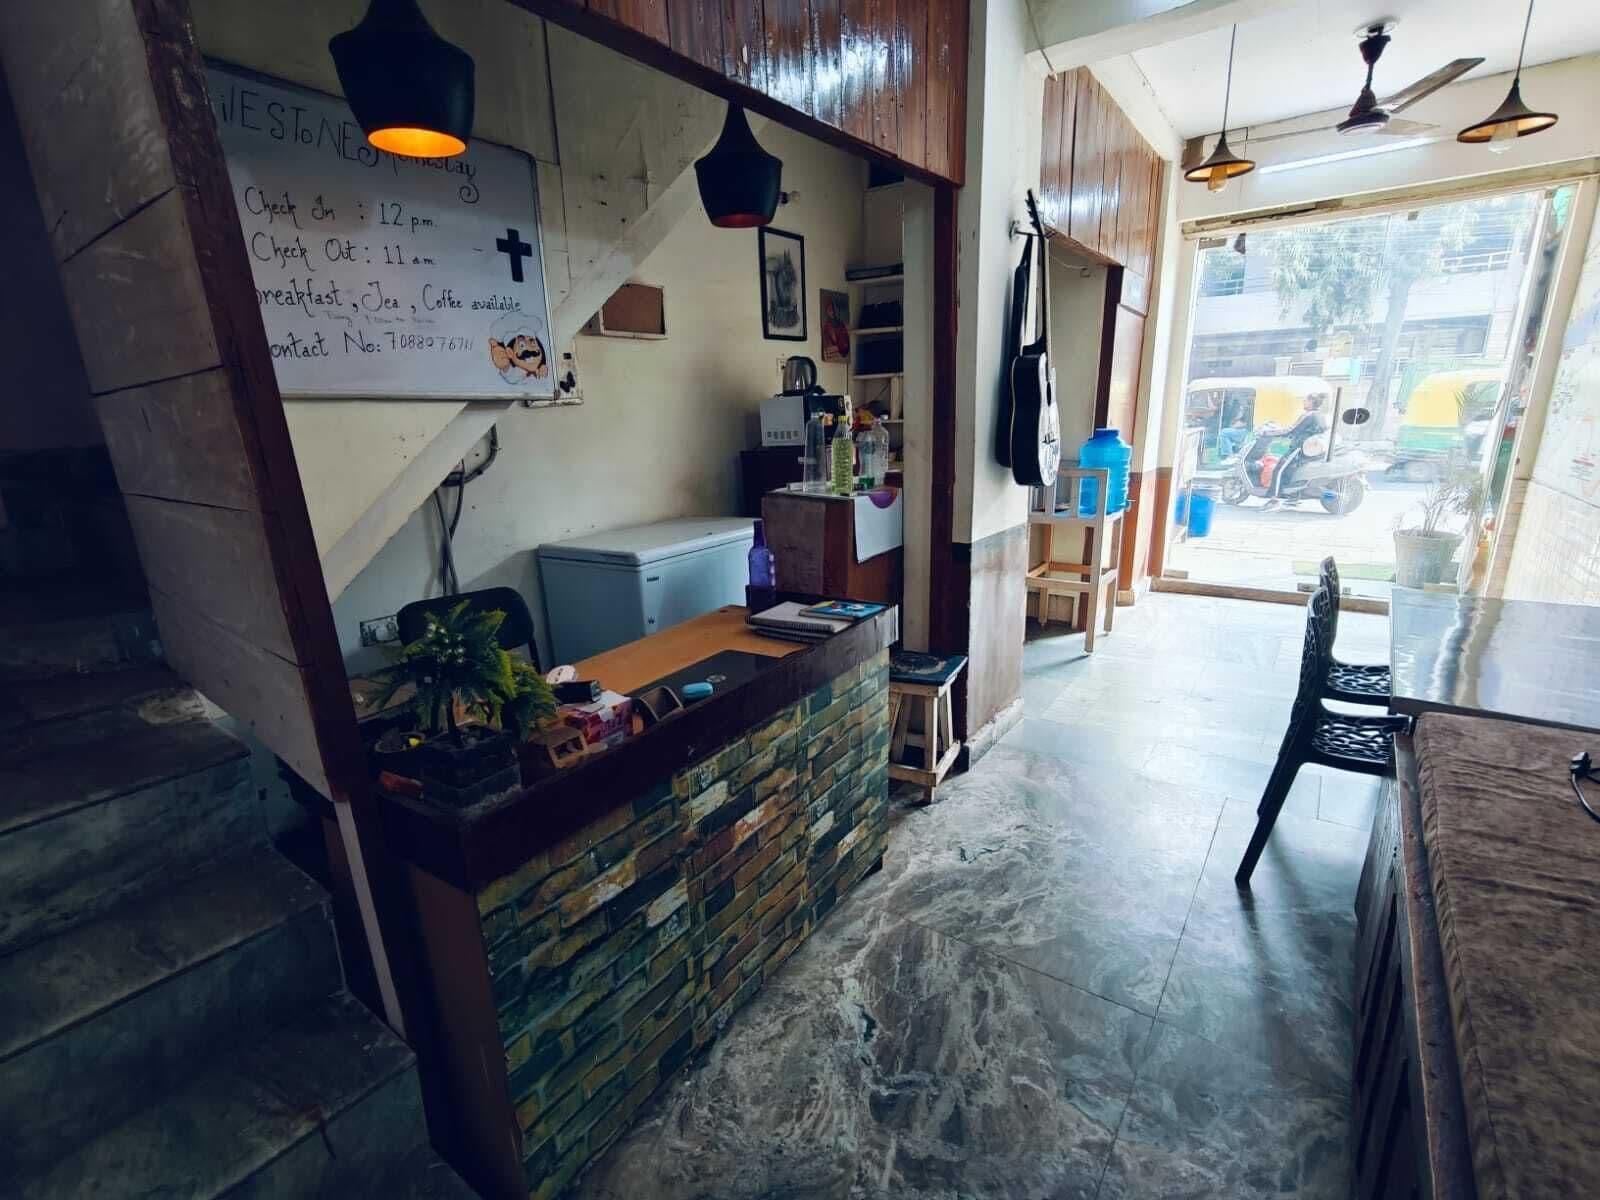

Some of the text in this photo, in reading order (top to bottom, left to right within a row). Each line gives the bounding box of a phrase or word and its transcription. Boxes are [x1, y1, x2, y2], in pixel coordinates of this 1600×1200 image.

[245, 186, 303, 230] Check
[379, 203, 405, 227] 12
[252, 231, 316, 272] Check
[384, 245, 405, 265] 11
[257, 278, 343, 318] reakfast
[422, 283, 464, 312] Coffee
[471, 294, 522, 313] available
[270, 331, 329, 360] ontact
